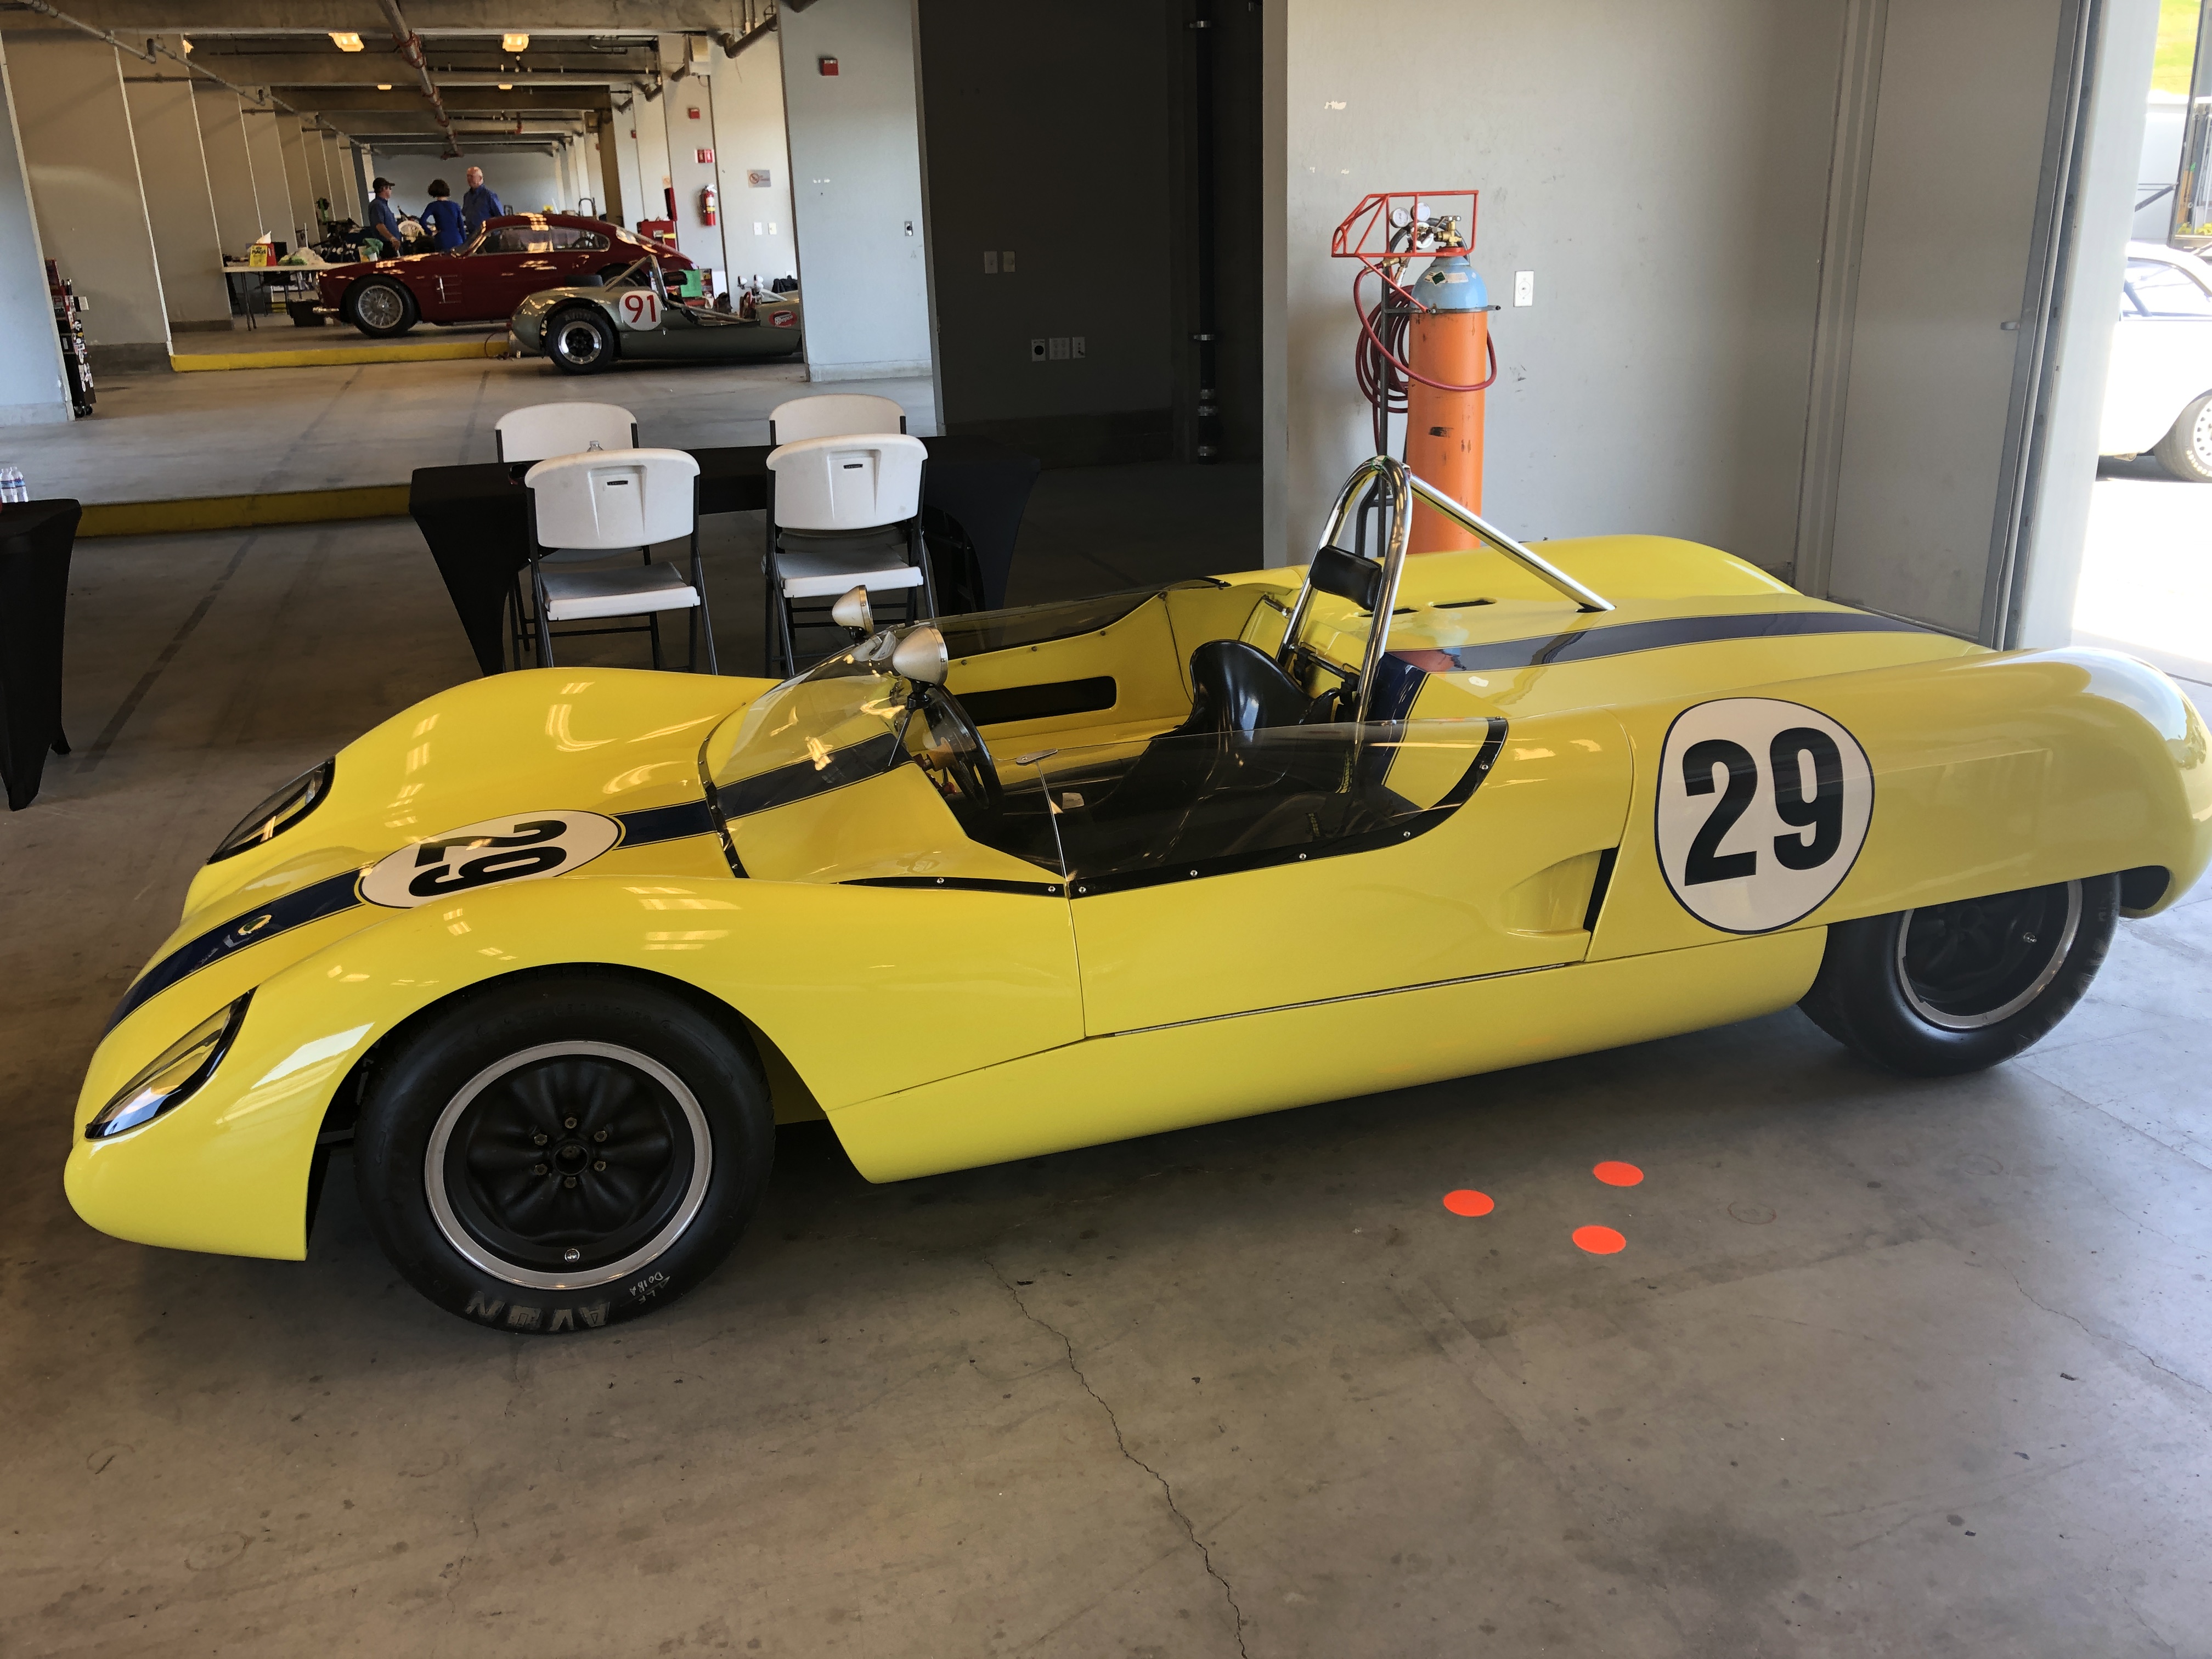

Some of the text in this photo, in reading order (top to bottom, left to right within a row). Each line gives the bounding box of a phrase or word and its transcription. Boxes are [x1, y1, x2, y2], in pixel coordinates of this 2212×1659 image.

[624, 295, 657, 323] 91
[1682, 727, 1844, 886] 29
[408, 820, 567, 897] 29
[465, 1290, 610, 1331] AVON
